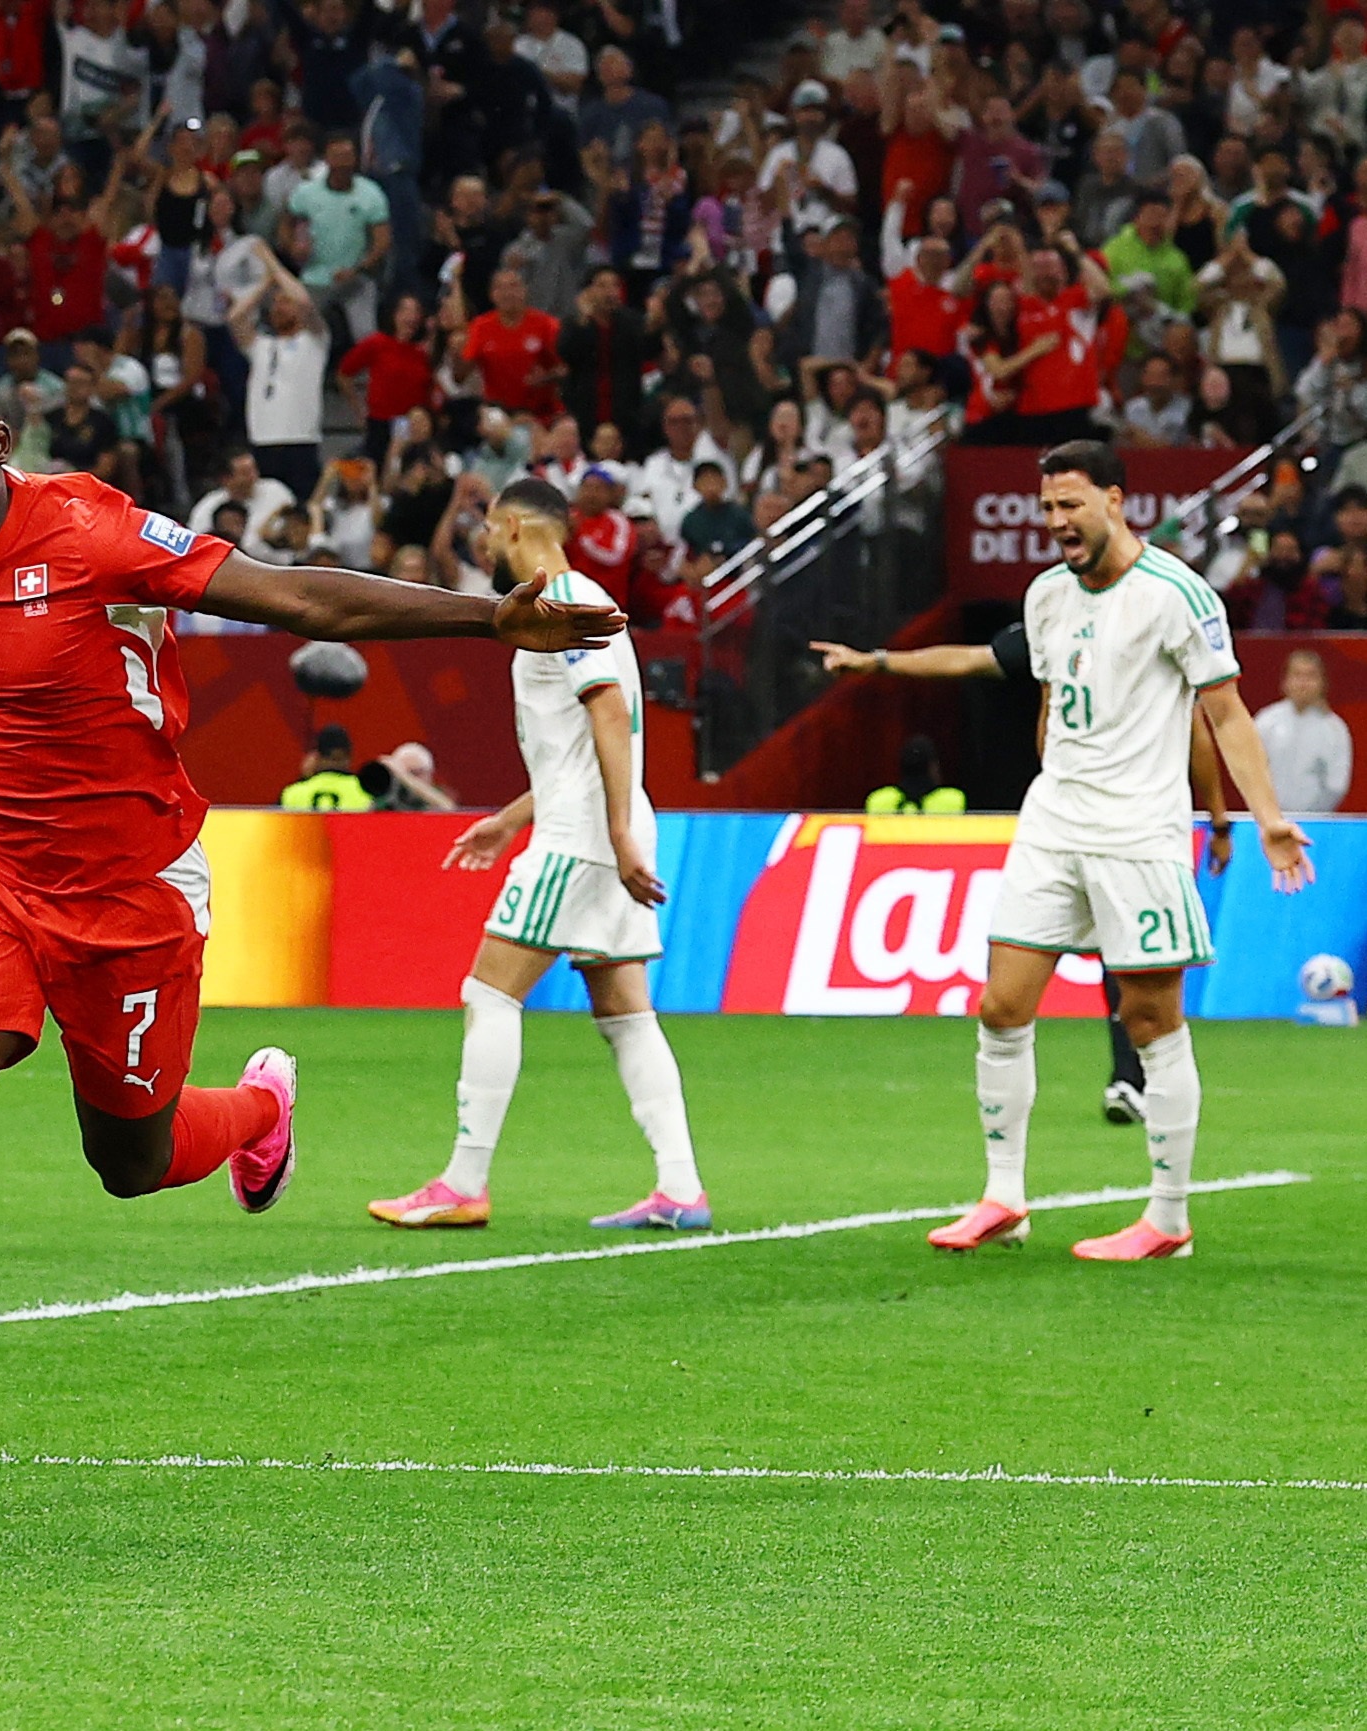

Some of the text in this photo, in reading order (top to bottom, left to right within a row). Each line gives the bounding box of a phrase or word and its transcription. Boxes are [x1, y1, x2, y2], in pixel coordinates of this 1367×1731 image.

[971, 529, 1020, 563] DE
[1061, 683, 1093, 730] 21
[498, 885, 523, 926] 9
[1137, 907, 1178, 953] 21
[123, 988, 159, 1067] 7
